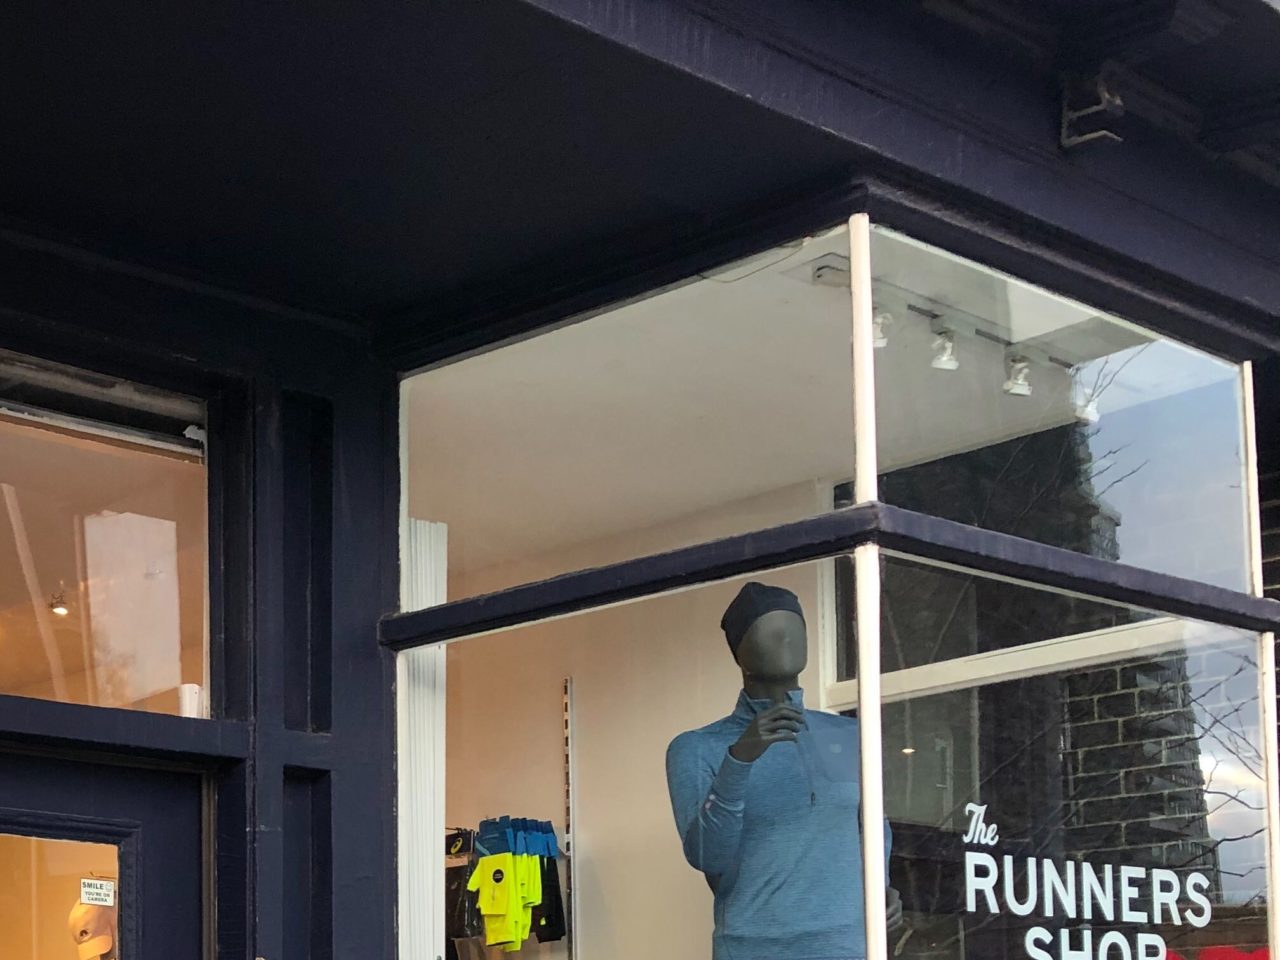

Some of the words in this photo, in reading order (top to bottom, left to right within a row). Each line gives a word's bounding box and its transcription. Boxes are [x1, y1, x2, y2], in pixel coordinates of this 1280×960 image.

[963, 803, 999, 845] The
[82, 882, 104, 890] SMILE
[965, 851, 1211, 928] RUNNERS
